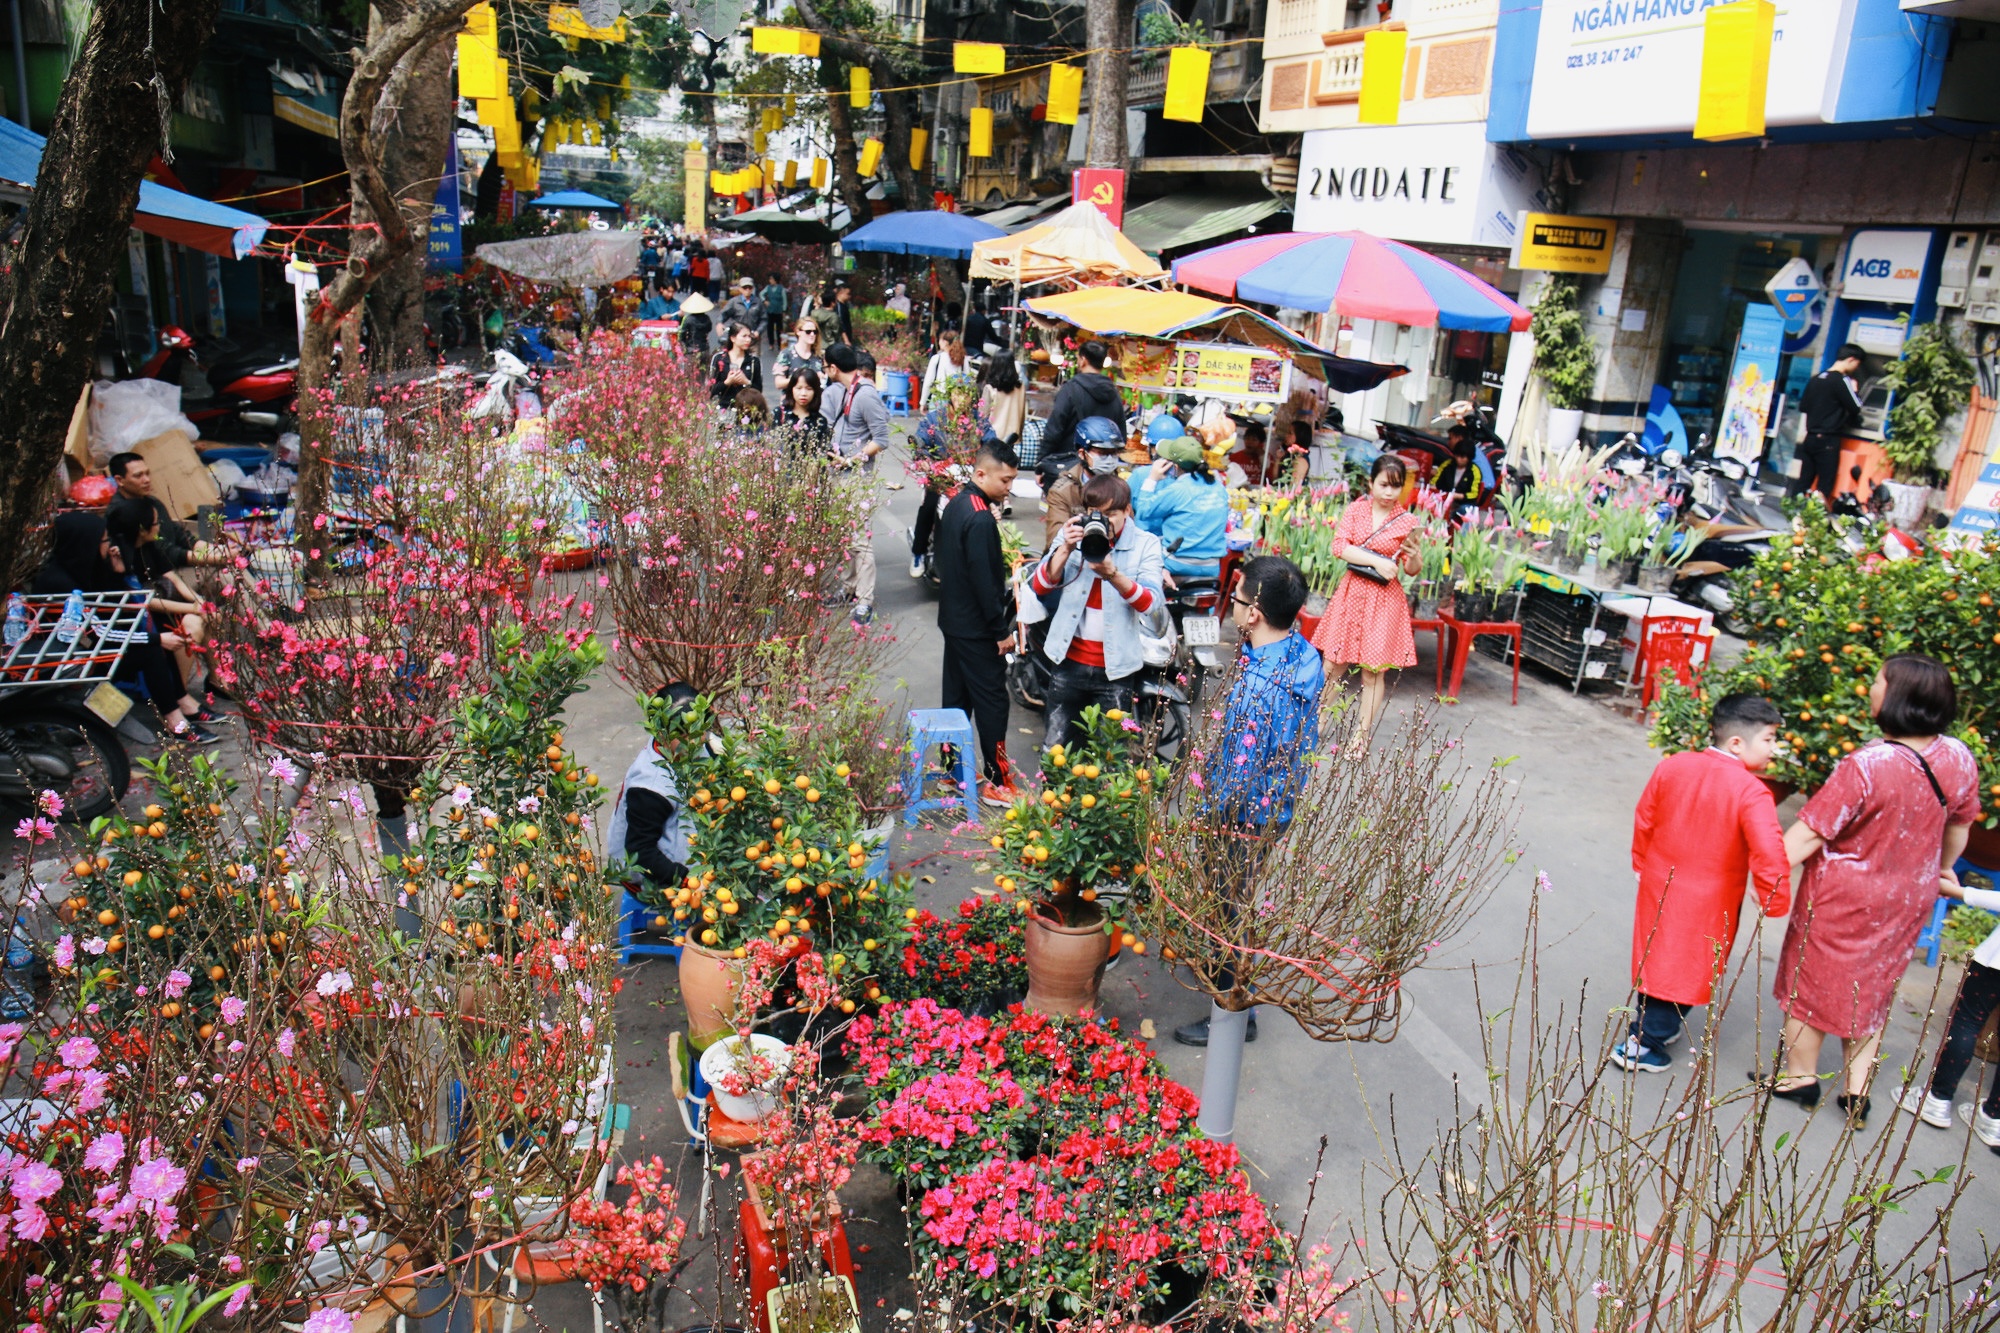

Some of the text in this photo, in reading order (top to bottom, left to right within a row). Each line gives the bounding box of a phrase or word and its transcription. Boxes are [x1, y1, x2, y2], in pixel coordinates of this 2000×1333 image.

[1601, 49, 1620, 64] 247
[1623, 45, 1643, 61] 247
[1535, 226, 1576, 237] WESTERN
[1850, 258, 1920, 280] ACB ATM
[1189, 620, 1214, 632] 29-P7
[1191, 632, 1216, 643] 4518
